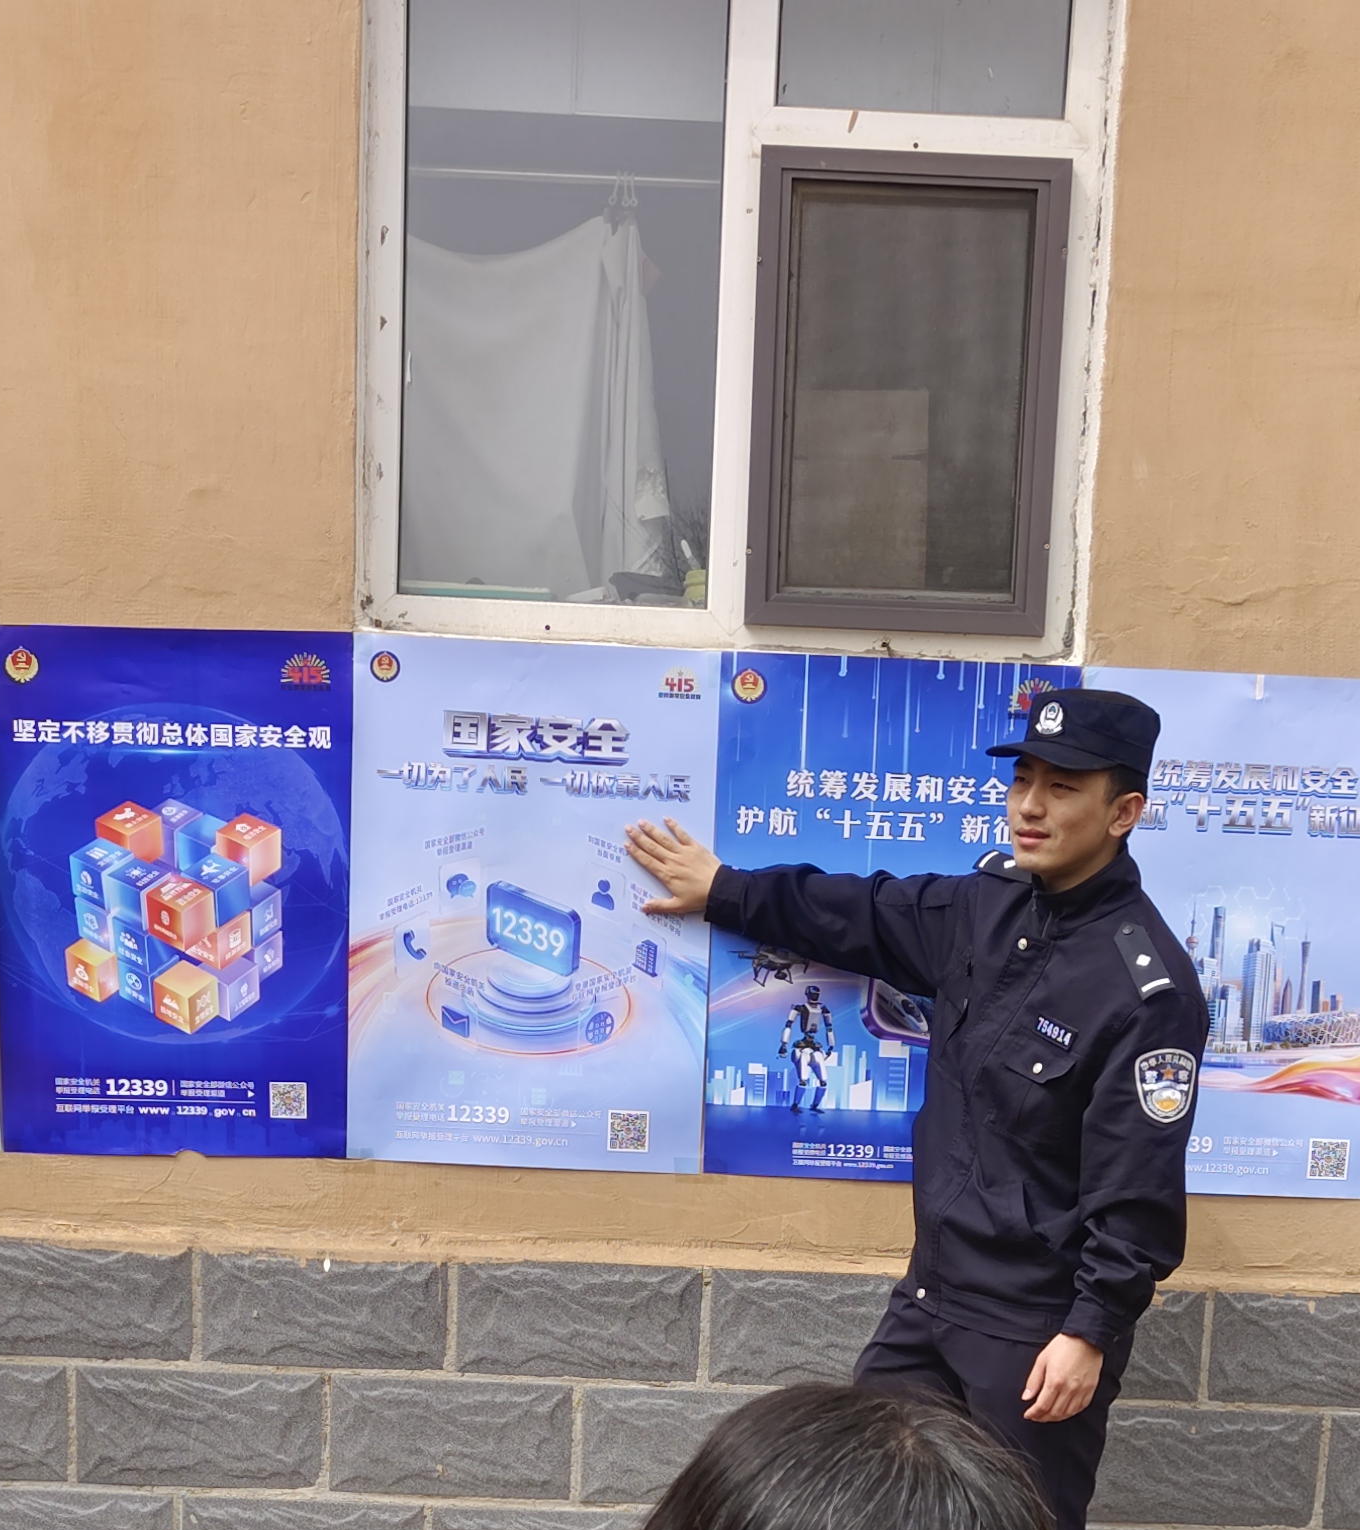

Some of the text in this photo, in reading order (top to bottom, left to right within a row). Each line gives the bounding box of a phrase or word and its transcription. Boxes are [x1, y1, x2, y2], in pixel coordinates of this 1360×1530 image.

[665, 677, 695, 692] 415
[12, 718, 332, 750] 坚定不移贯彻总体国家安全观
[443, 710, 630, 766] 国家安全
[377, 761, 692, 803] 一切为了人民 一切依靠人民
[785, 769, 1007, 807] 统筹发展和安全
[1152, 760, 1359, 799] 统筹发展和安全
[736, 804, 1012, 845] 护航“十五五”新征
[492, 906, 566, 957] 12339
[106, 1079, 168, 1096] 12339
[448, 1104, 510, 1124] 12339
[473, 1134, 568, 1147] www.12339.gov.cn
[827, 1144, 874, 1158] 12339
[1185, 1163, 1269, 1176] ww.12339.gov.cn
